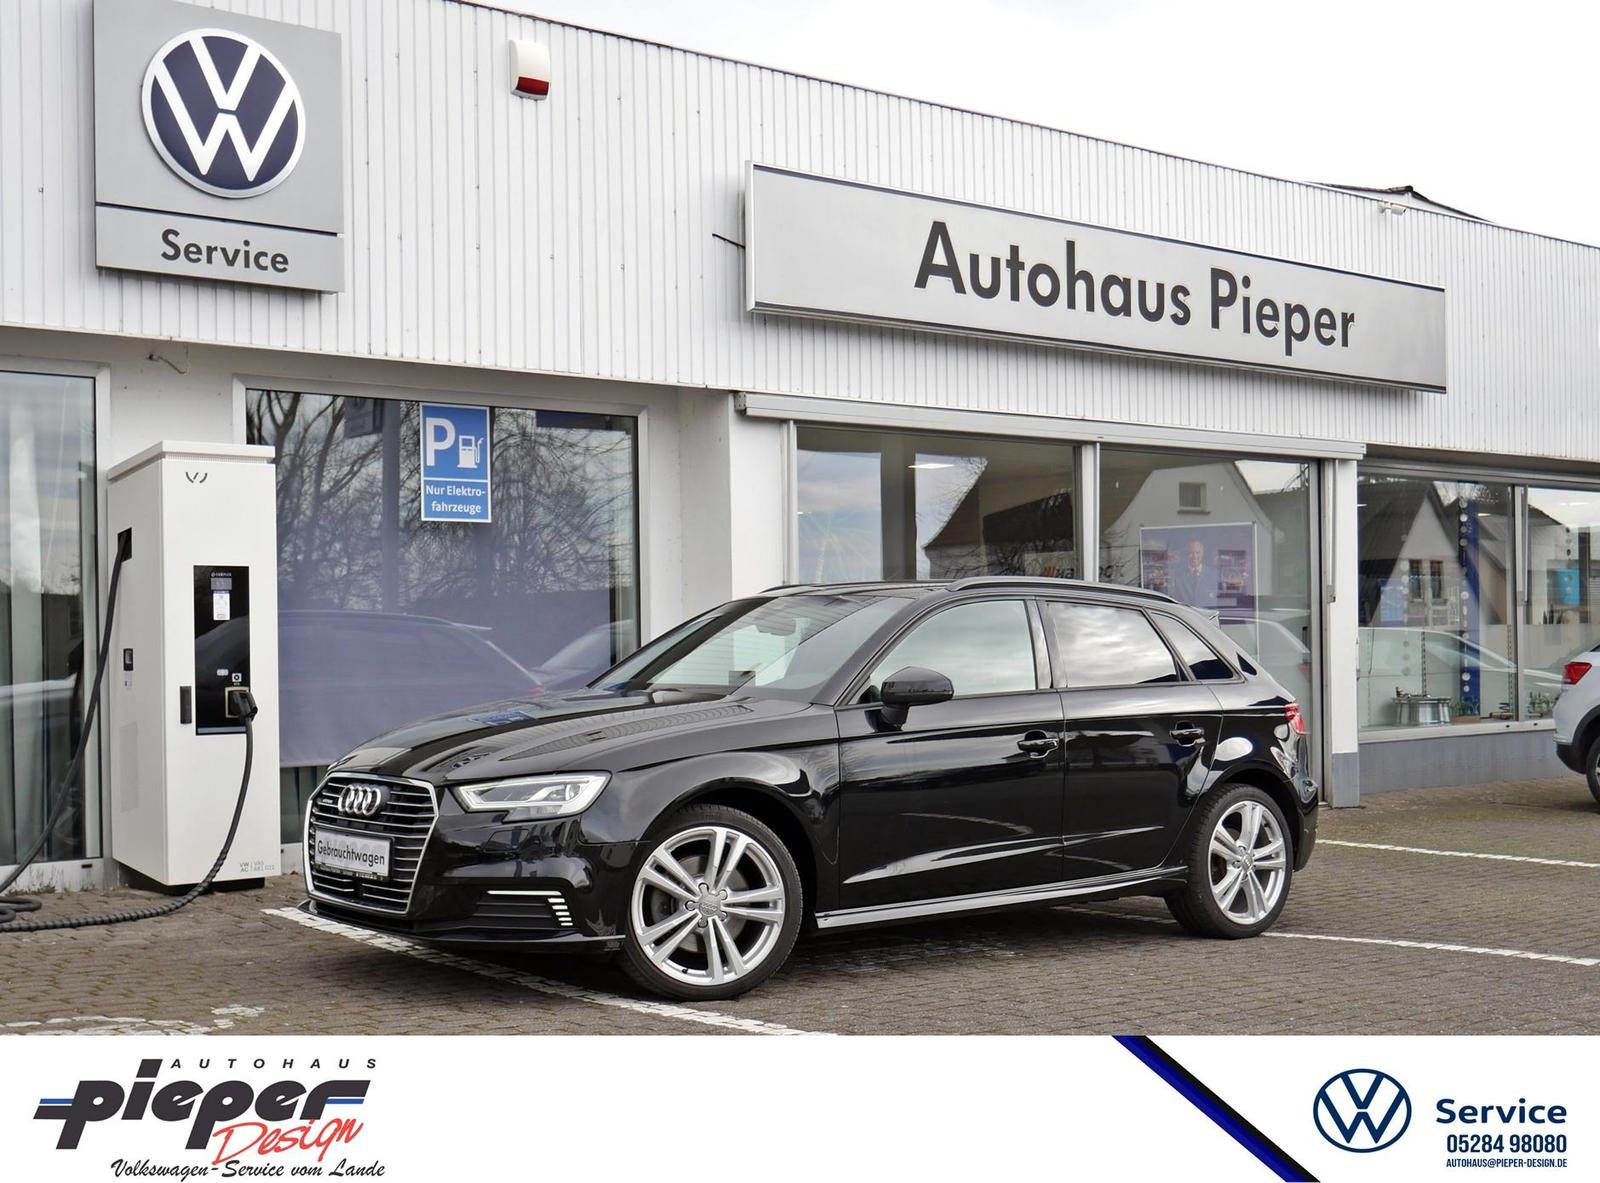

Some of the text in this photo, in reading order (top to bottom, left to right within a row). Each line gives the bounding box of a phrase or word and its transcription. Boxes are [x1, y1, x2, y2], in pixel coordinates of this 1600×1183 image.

[161, 228, 289, 273] Service
[914, 220, 1356, 356] Autohaus Pieper
[425, 417, 456, 467] P
[425, 485, 486, 497] Nur Elektro-
[431, 501, 482, 515] fahrzeuge
[318, 842, 385, 867] Gebrauchtwagen
